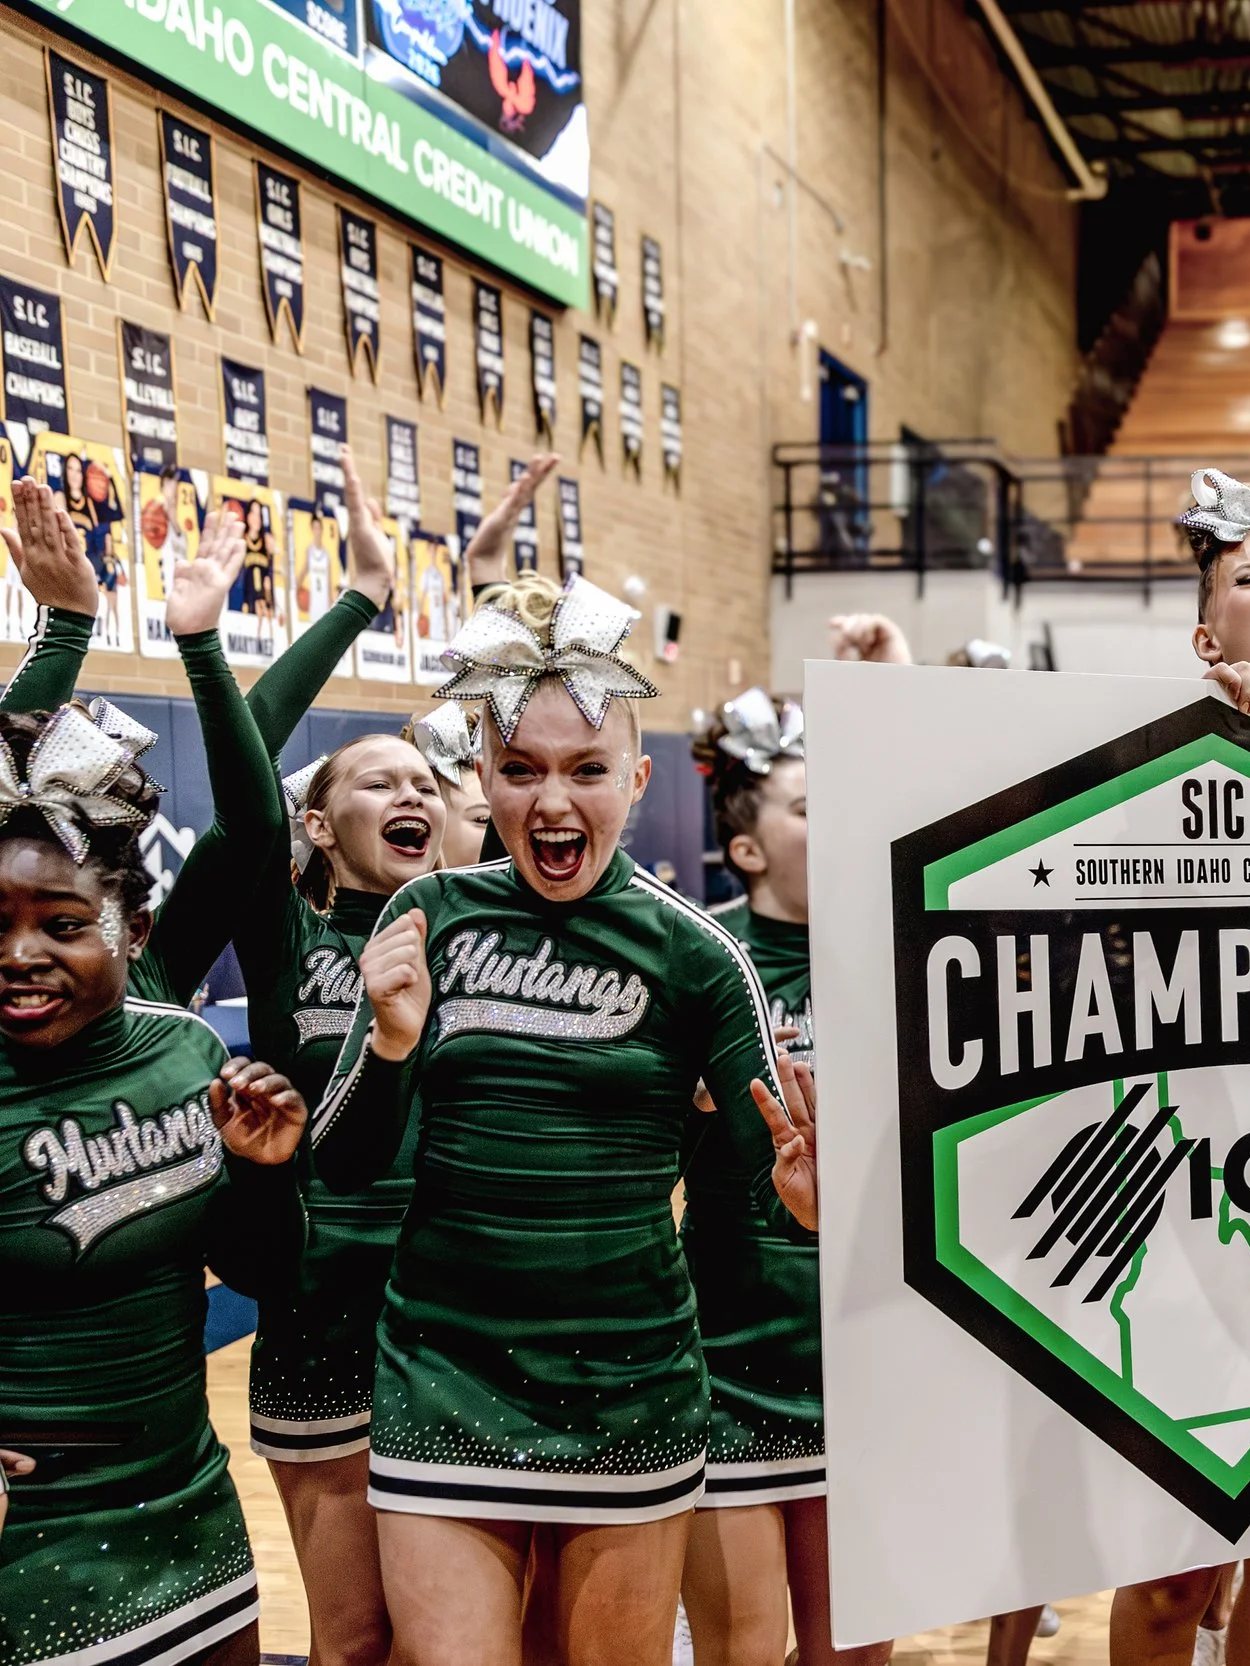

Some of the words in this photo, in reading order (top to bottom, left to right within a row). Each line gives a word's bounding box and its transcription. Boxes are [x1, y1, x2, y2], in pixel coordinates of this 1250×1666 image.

[122, 0, 255, 76] DAHO
[262, 44, 409, 173] CENTRAL
[413, 139, 505, 229] CREDIT
[508, 196, 579, 277] UNION
[1182, 778, 1244, 840] SIC
[1075, 858, 1165, 886] SOUTHERN
[1176, 857, 1231, 884] IDAHO
[440, 929, 649, 1016] Mustangs
